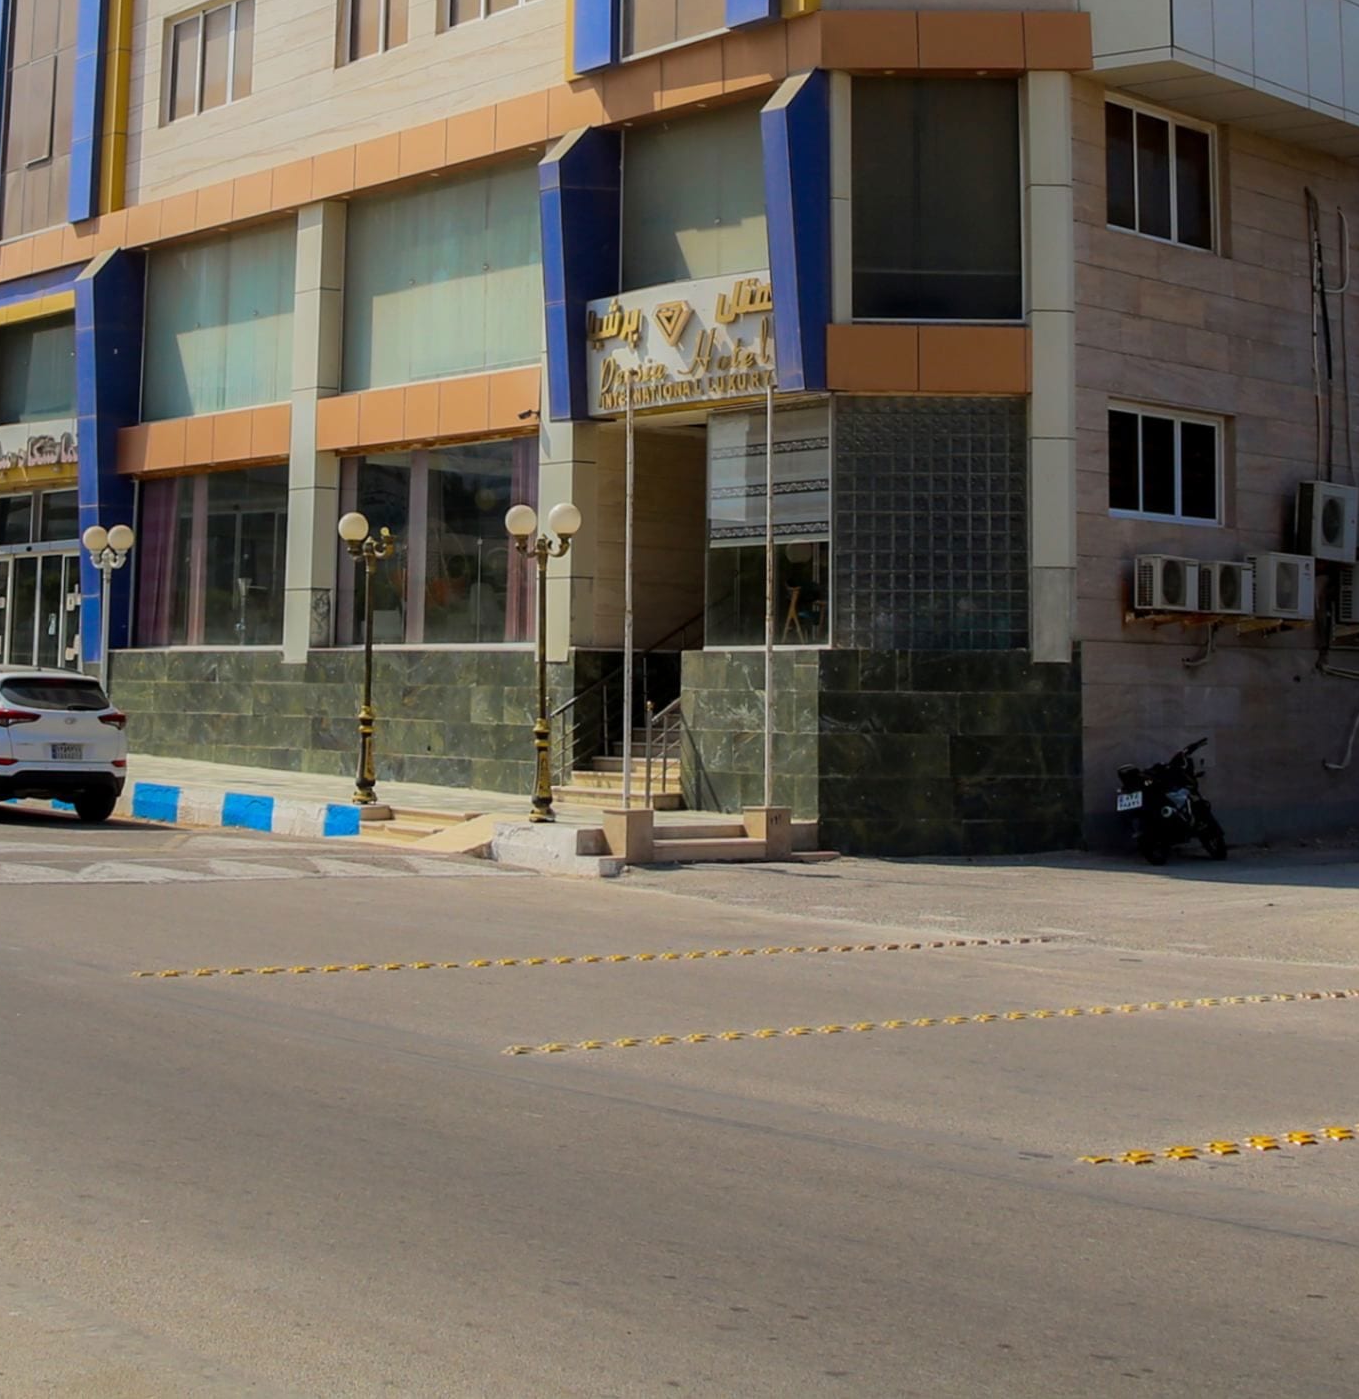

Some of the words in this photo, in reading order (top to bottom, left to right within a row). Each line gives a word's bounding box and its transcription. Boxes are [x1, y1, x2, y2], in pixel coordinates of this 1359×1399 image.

[588, 298, 642, 351] پرشیا
[677, 315, 771, 374] Hotel
[601, 378, 703, 410] INTENATIONAL
[708, 369, 773, 393] LUXURY
